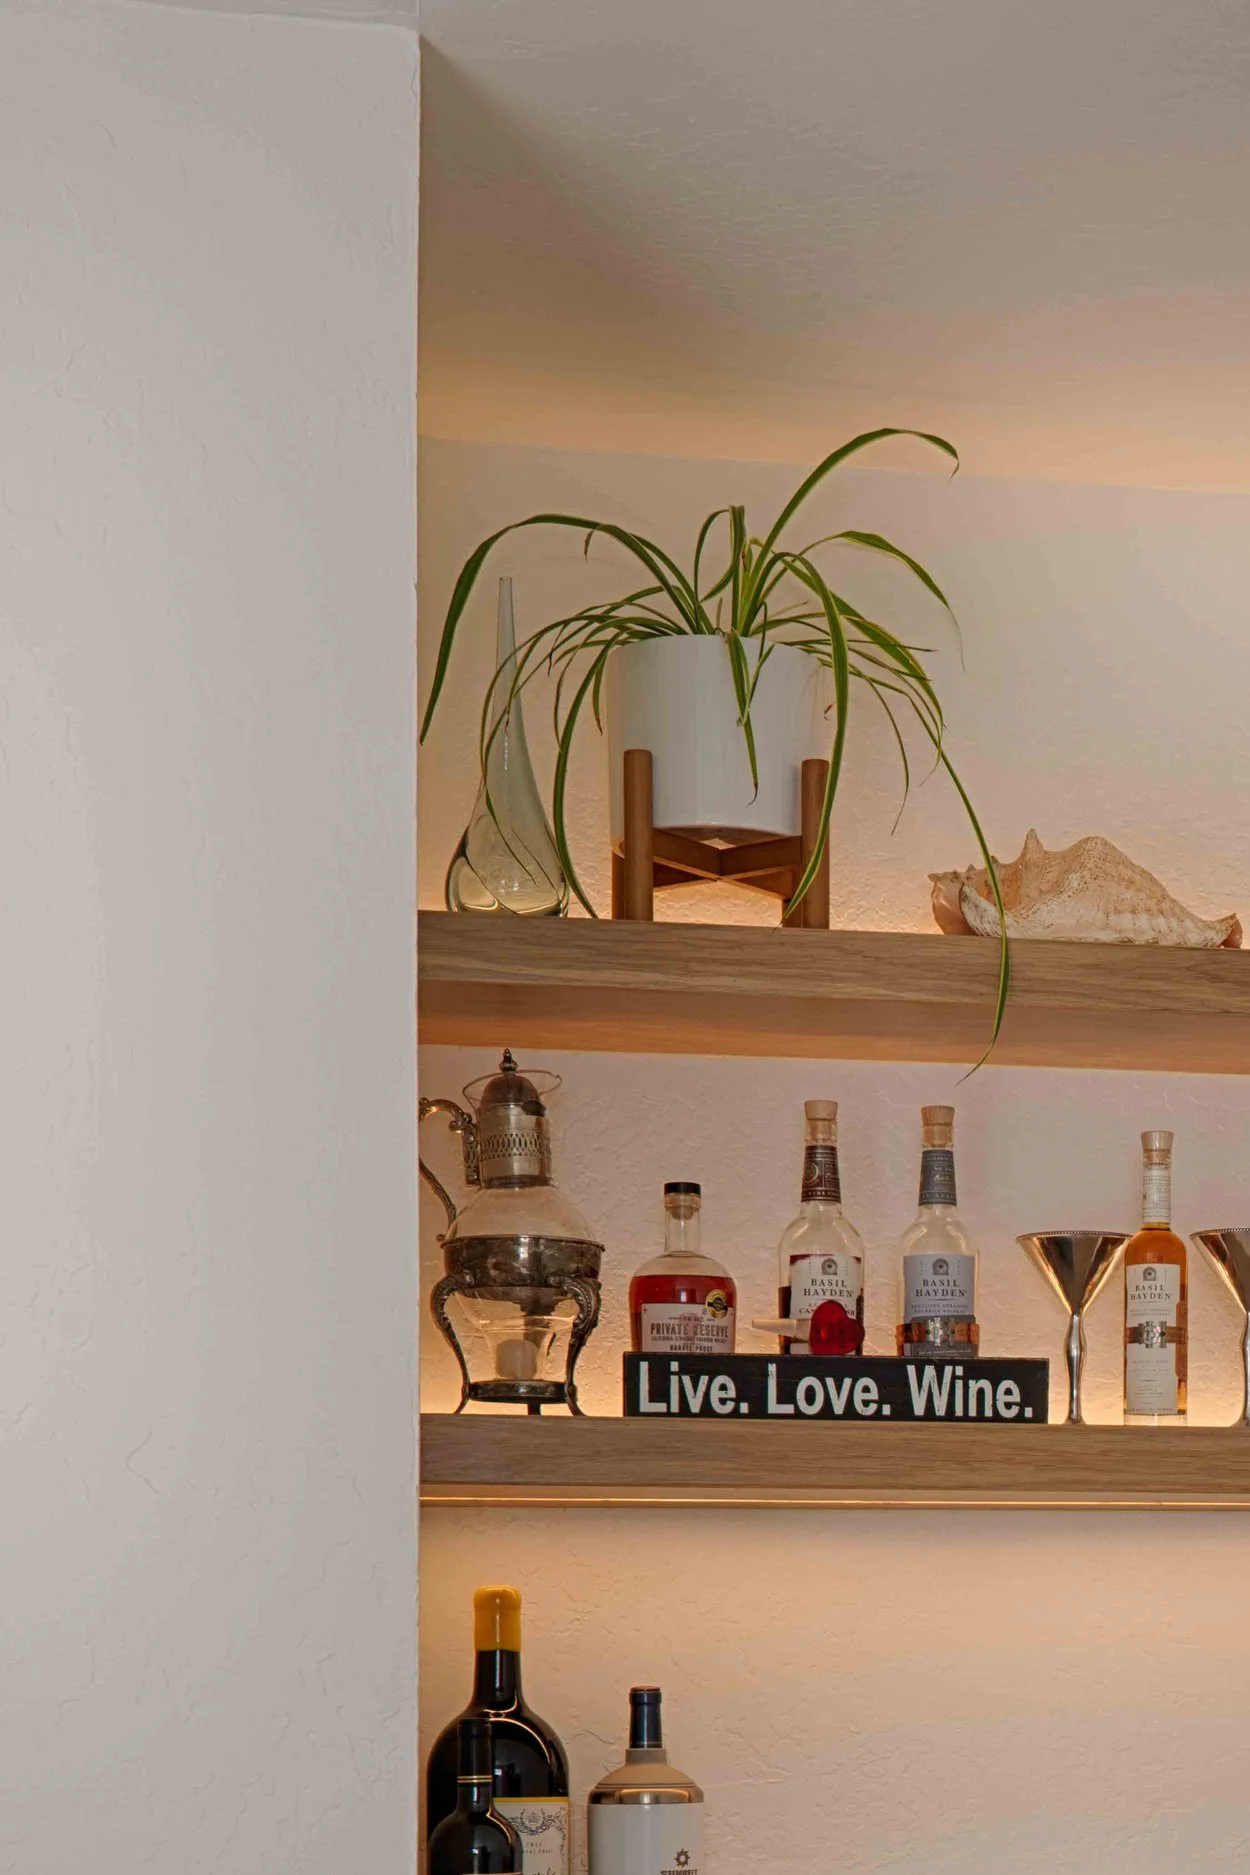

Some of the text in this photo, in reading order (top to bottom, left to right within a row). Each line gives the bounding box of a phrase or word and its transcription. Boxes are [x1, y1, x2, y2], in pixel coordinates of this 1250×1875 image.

[811, 1279, 847, 1288] BASIL
[922, 1279, 960, 1287] BASIL
[915, 1288, 965, 1297] HAYDEN
[1135, 1284, 1166, 1292] BASIL
[803, 1288, 853, 1298] HAYDEN
[1130, 1292, 1171, 1301] HAYDEN
[650, 1322, 729, 1339] PRIVATE RESERVE
[669, 1344, 713, 1353] BARREL PROOF
[638, 1360, 1033, 1419] Live. Love. Wine.
